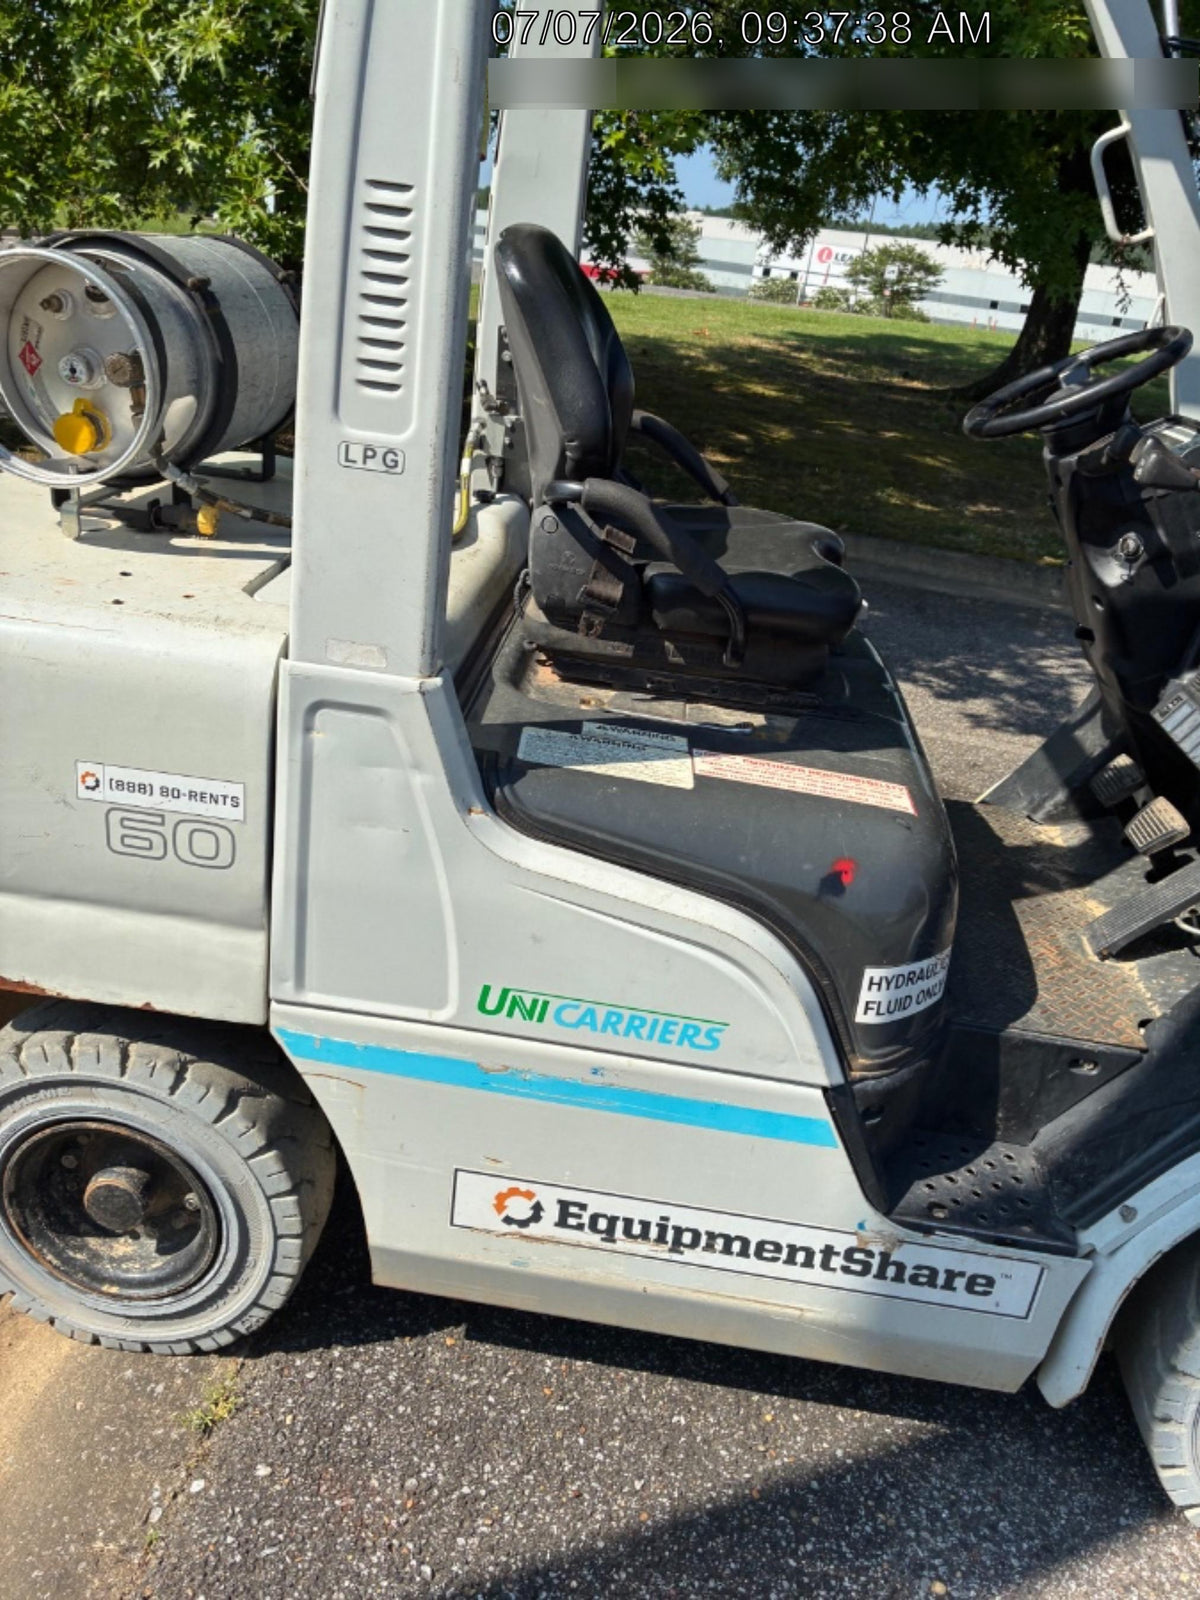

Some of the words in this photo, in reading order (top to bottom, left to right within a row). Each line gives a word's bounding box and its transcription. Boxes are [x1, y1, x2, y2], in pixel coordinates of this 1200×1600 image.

[343, 443, 400, 470] LPG
[109, 777, 154, 797] (888)
[159, 785, 241, 809] 80-RENTS
[105, 806, 236, 870] 60
[863, 994, 913, 1016] FLUID
[553, 1198, 996, 1297] EquipmentShare
